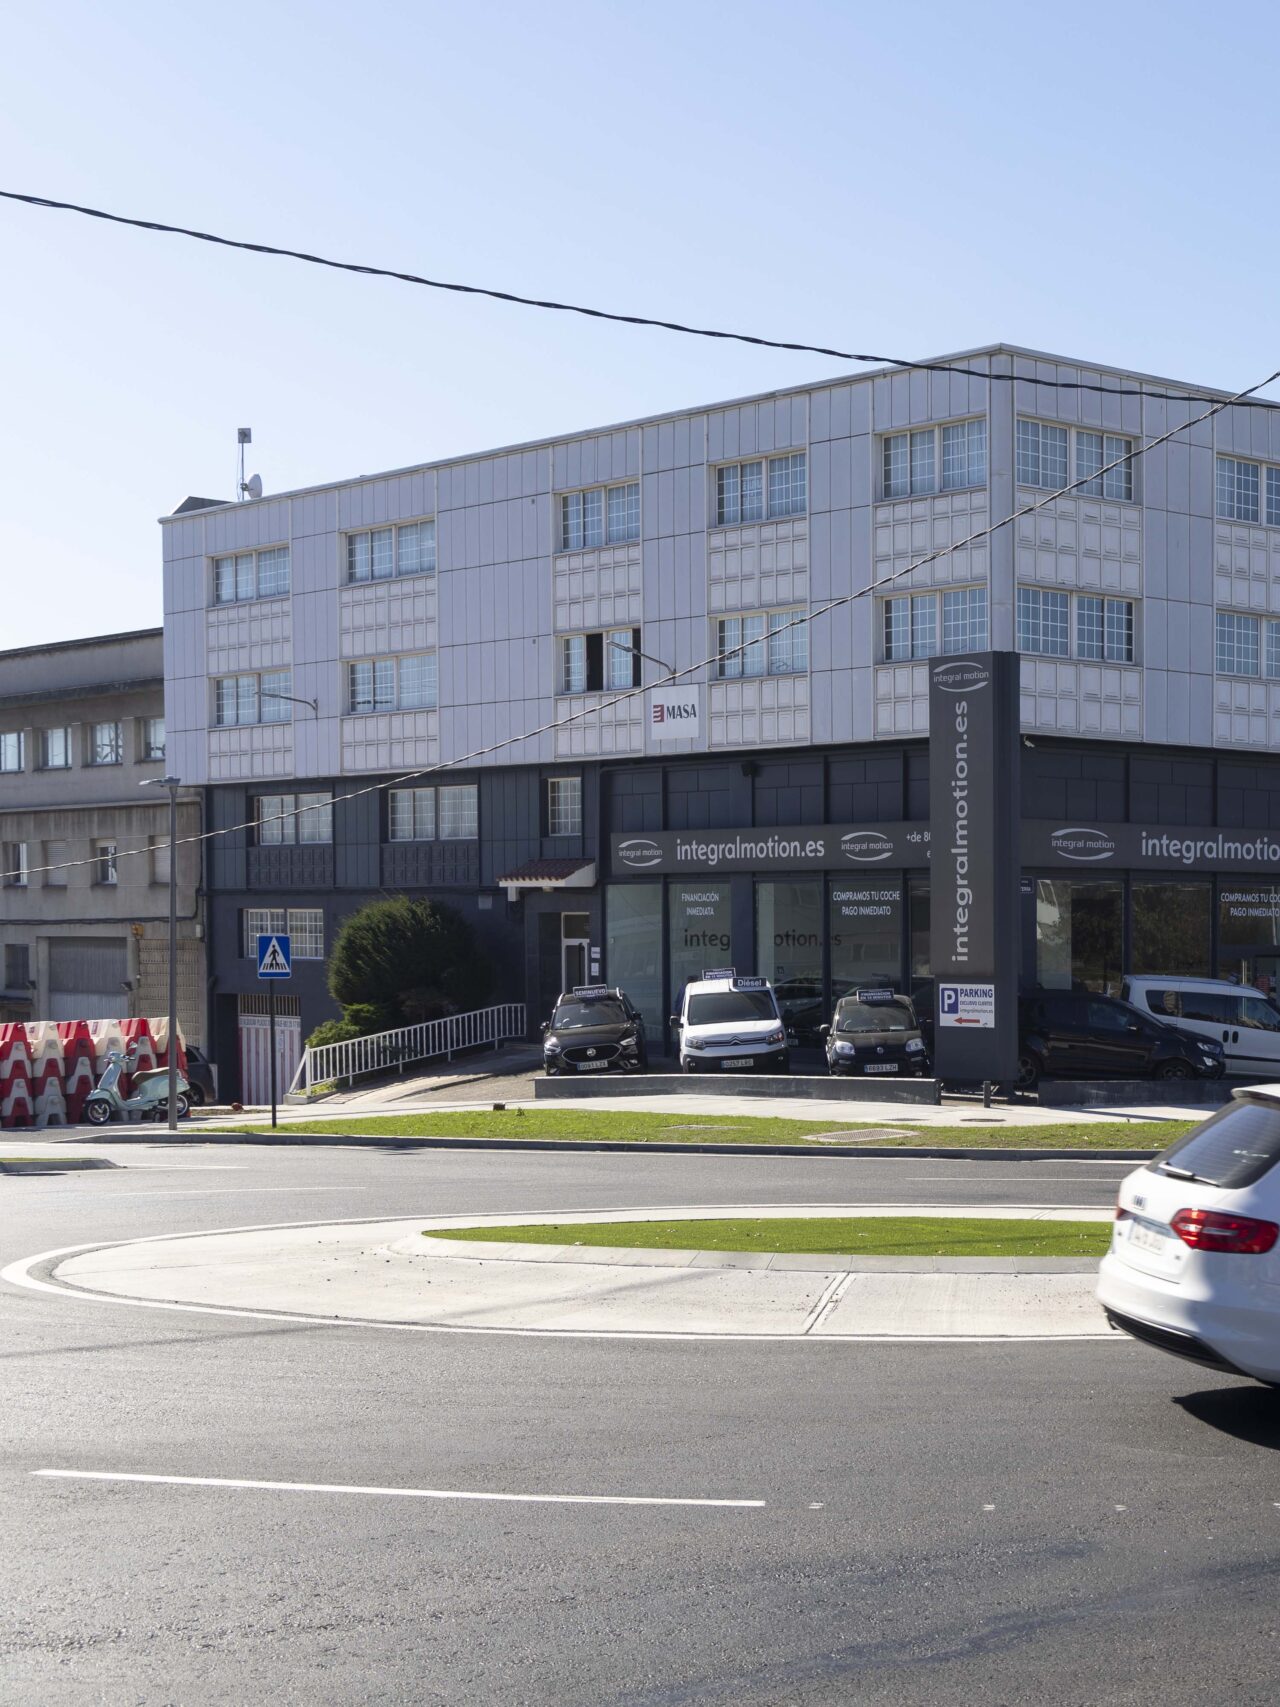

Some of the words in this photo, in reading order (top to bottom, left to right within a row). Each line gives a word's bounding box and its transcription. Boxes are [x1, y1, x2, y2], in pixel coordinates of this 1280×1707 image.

[933, 672, 962, 684] integral
[963, 670, 989, 680] motion
[666, 703, 697, 720] MASA
[951, 701, 973, 962] integralmotion.es
[841, 842, 868, 852] integral
[869, 841, 894, 850] motion
[1051, 837, 1085, 851] integral
[1086, 839, 1115, 849] motion
[618, 849, 642, 859] integral
[642, 848, 663, 857] motion
[676, 835, 825, 866] integralmotion.es
[833, 891, 870, 901] COMPRAMOS
[871, 891, 880, 901] TU
[880, 890, 901, 901] COCHE
[1220, 892, 1259, 903] COMPRAMOS
[1260, 893, 1268, 903] TU
[686, 906, 714, 916] INMEDIATA
[842, 905, 858, 916] PAGO
[859, 905, 892, 916] INMEDIATO
[1230, 907, 1247, 917] PAGO
[1247, 907, 1280, 918] INMEDIATO
[684, 929, 842, 951] integotion.s
[737, 979, 762, 987] Diésel
[960, 988, 993, 998] PARKING
